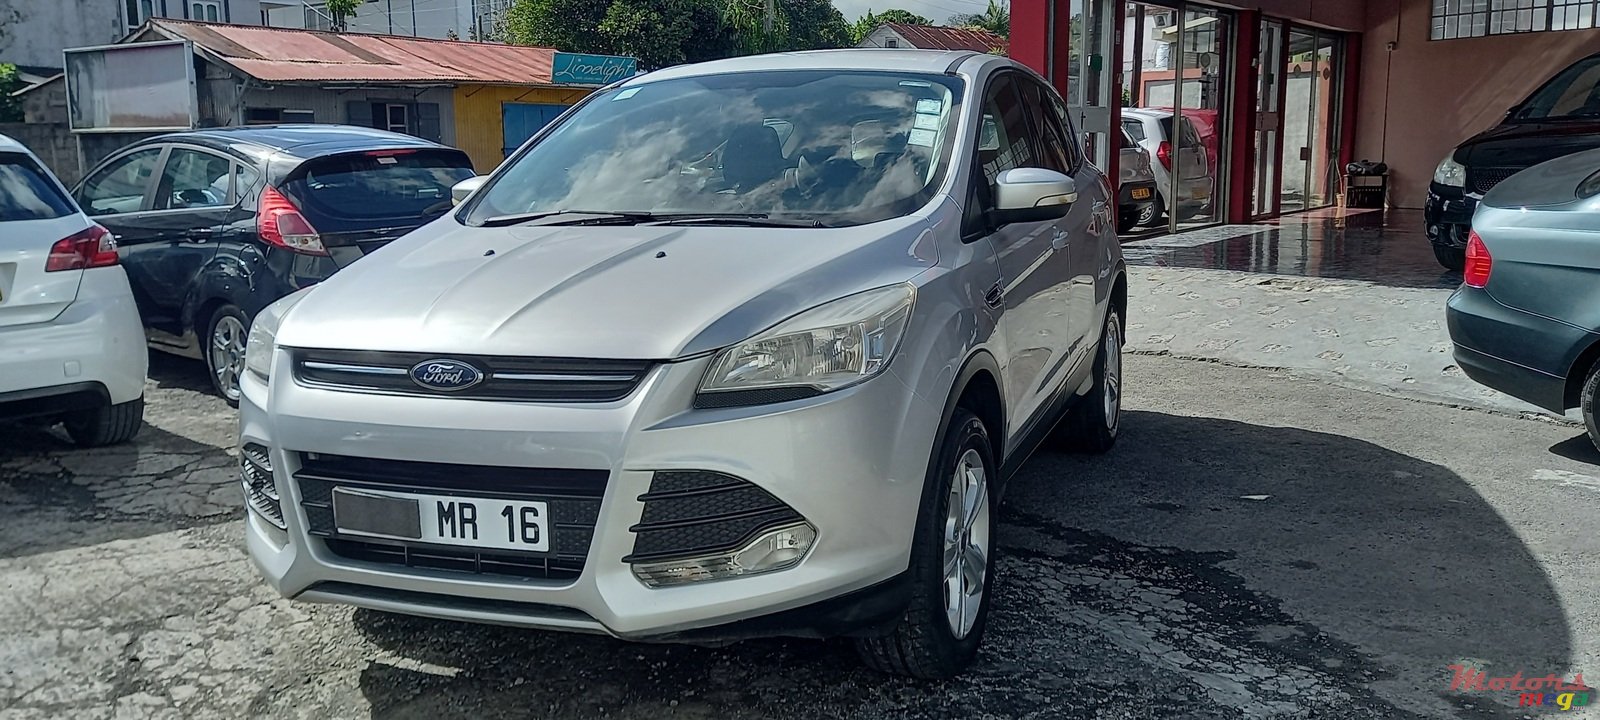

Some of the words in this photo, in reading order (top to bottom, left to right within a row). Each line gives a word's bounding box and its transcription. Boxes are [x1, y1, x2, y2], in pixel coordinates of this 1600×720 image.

[555, 55, 635, 83] Limelight
[423, 363, 464, 384] Ford
[436, 500, 478, 539] MR
[501, 505, 540, 544] 16
